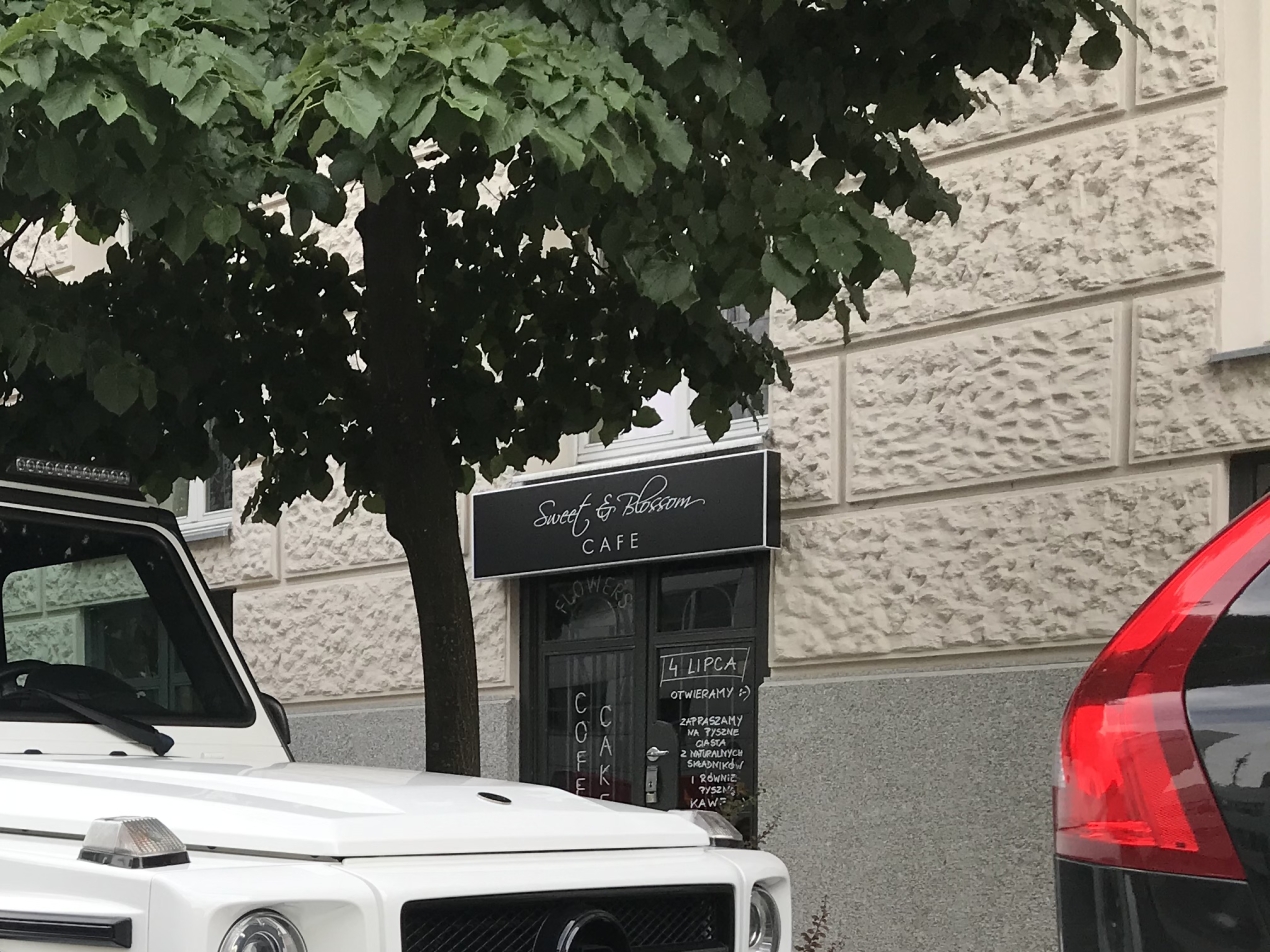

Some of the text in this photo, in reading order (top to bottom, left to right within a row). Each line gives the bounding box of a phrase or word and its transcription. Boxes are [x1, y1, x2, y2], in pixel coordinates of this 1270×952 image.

[533, 474, 706, 537] Sweet & Blossom
[582, 532, 639, 555] CAFE
[555, 574, 633, 614] FLOWERS
[668, 656, 737, 678] 4 LIPCA
[670, 686, 734, 700] OTWIERAMY
[679, 714, 744, 727] ZAPRASZAMY
[687, 727, 740, 737] NA PYSZNE
[695, 738, 727, 748] CIASTA
[690, 748, 744, 758] NATURALNYCH
